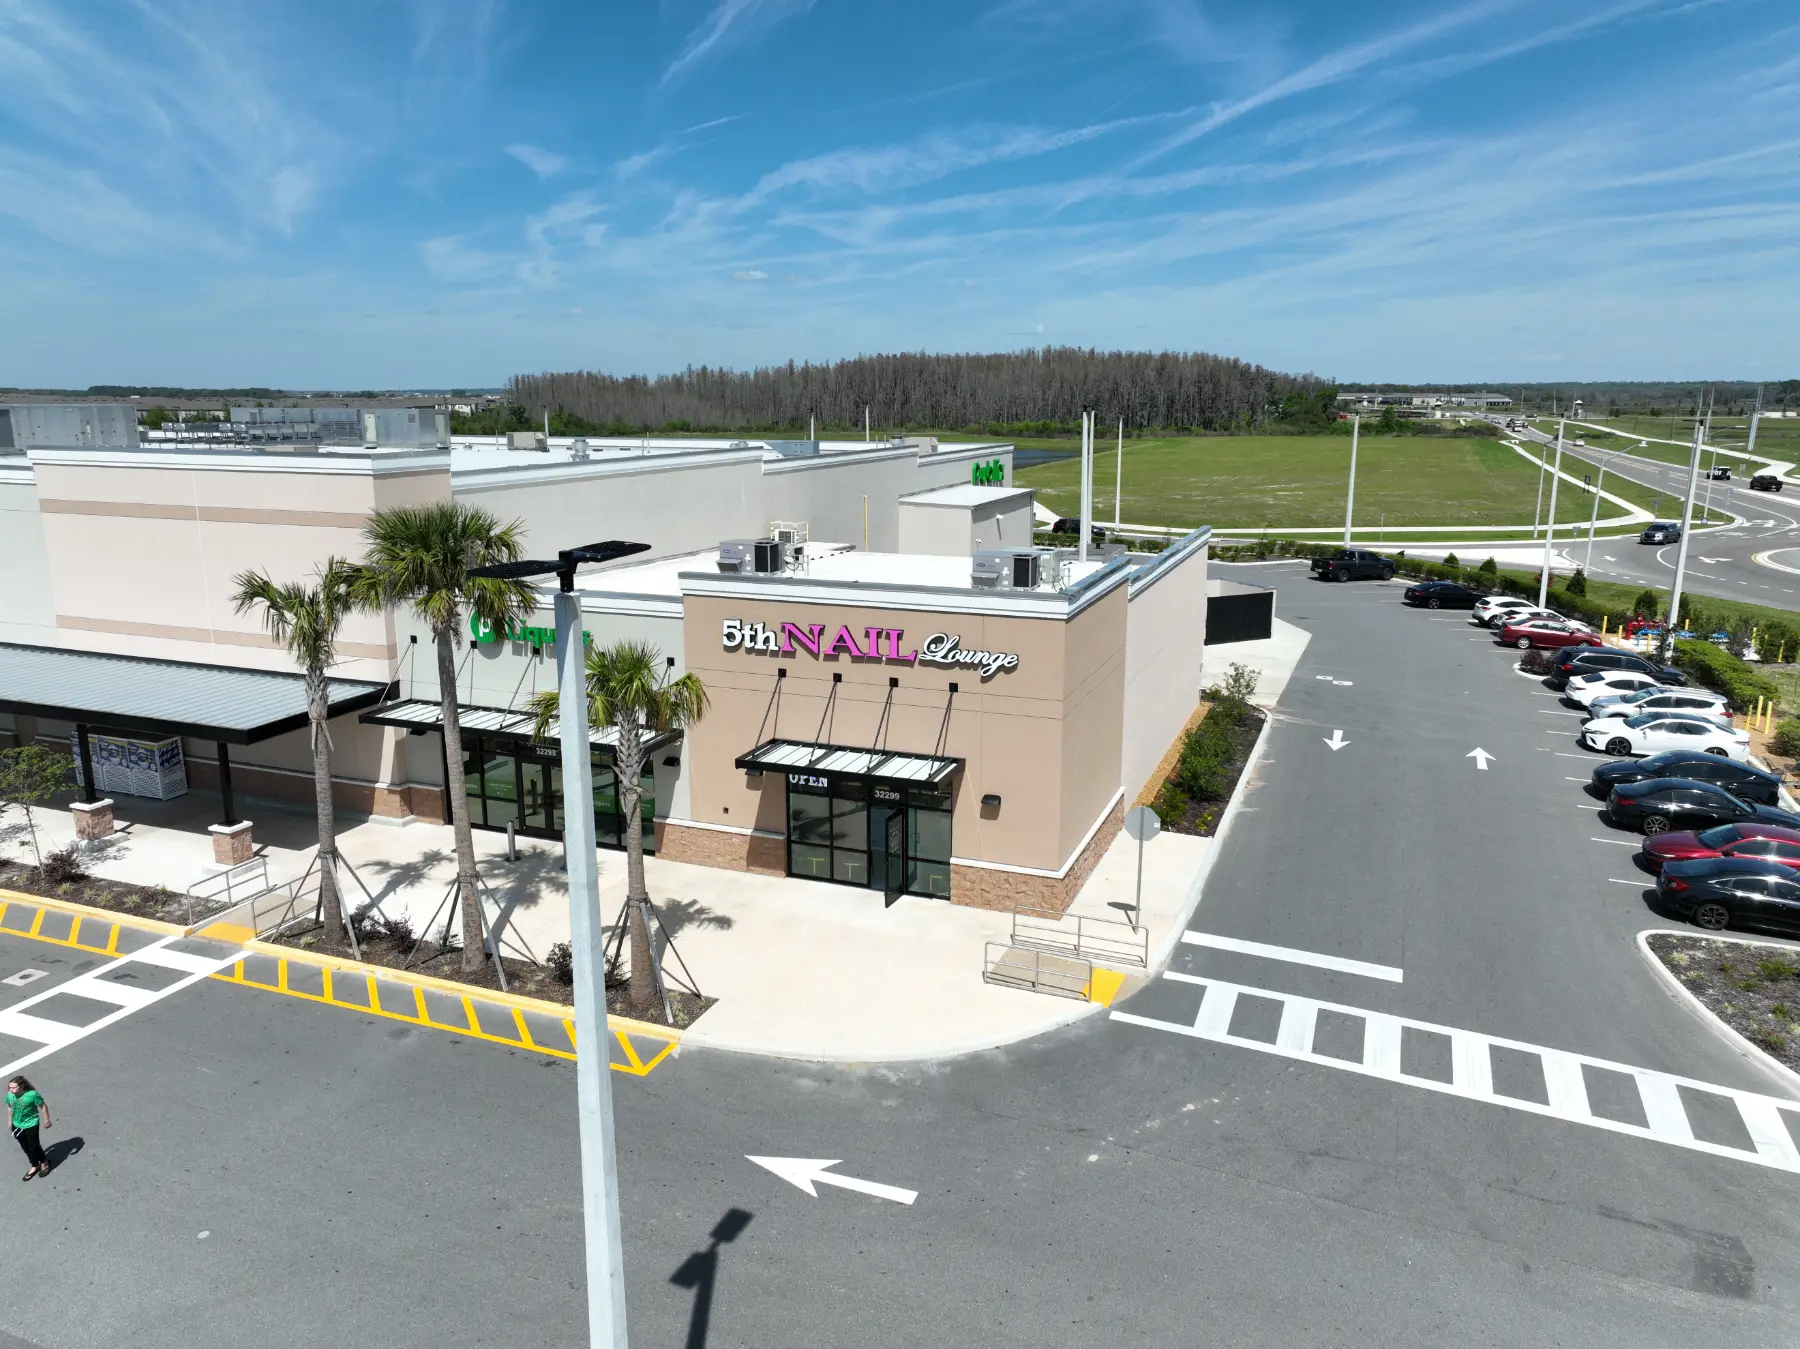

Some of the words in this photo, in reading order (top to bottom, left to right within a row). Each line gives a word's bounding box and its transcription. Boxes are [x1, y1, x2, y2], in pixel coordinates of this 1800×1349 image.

[507, 616, 592, 649] Liqus
[722, 618, 780, 652] 5th
[779, 622, 919, 663] NAIL
[918, 633, 1019, 677] Lounge
[535, 747, 557, 757] 32293
[788, 773, 828, 788] OPEN
[874, 790, 900, 801] 32299
